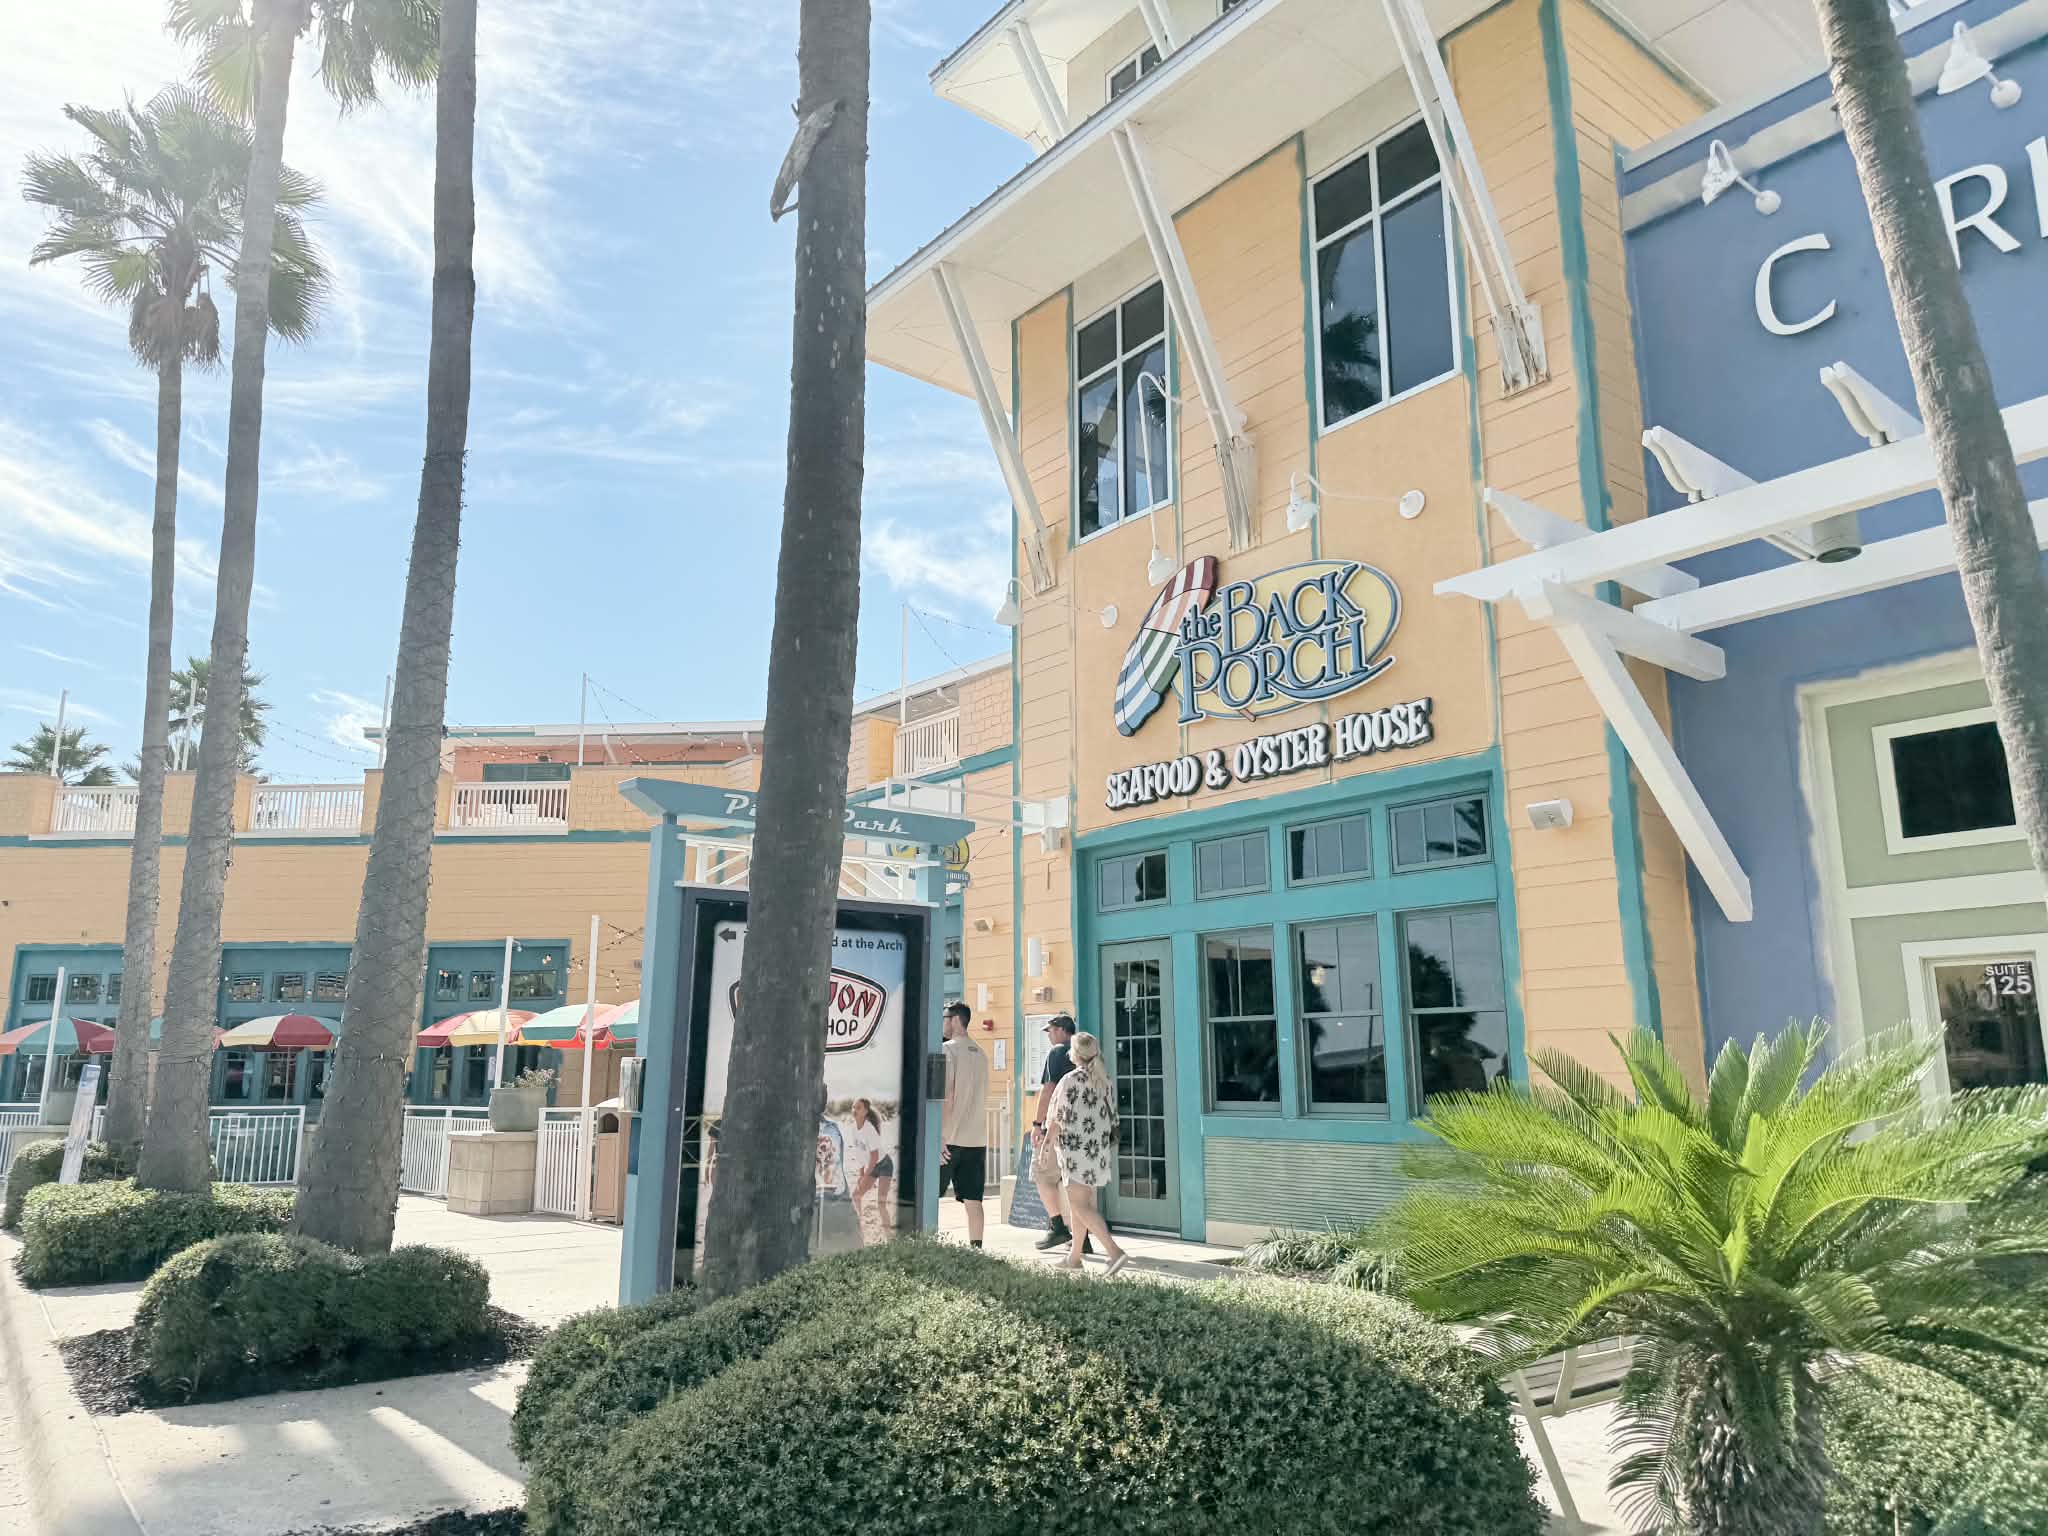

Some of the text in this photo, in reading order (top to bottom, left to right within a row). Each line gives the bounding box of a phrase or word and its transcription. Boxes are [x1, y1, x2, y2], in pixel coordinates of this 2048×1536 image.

[1180, 563, 1364, 657] the BACK
[1175, 618, 1394, 727] PORCH
[1105, 698, 1433, 810] SEAFOOD & OYSTER HOUSE
[841, 938, 853, 948] at
[856, 937, 874, 949] the
[876, 939, 903, 951] Arch
[1985, 964, 2026, 976] SUITE
[1985, 976, 2032, 995] 125
